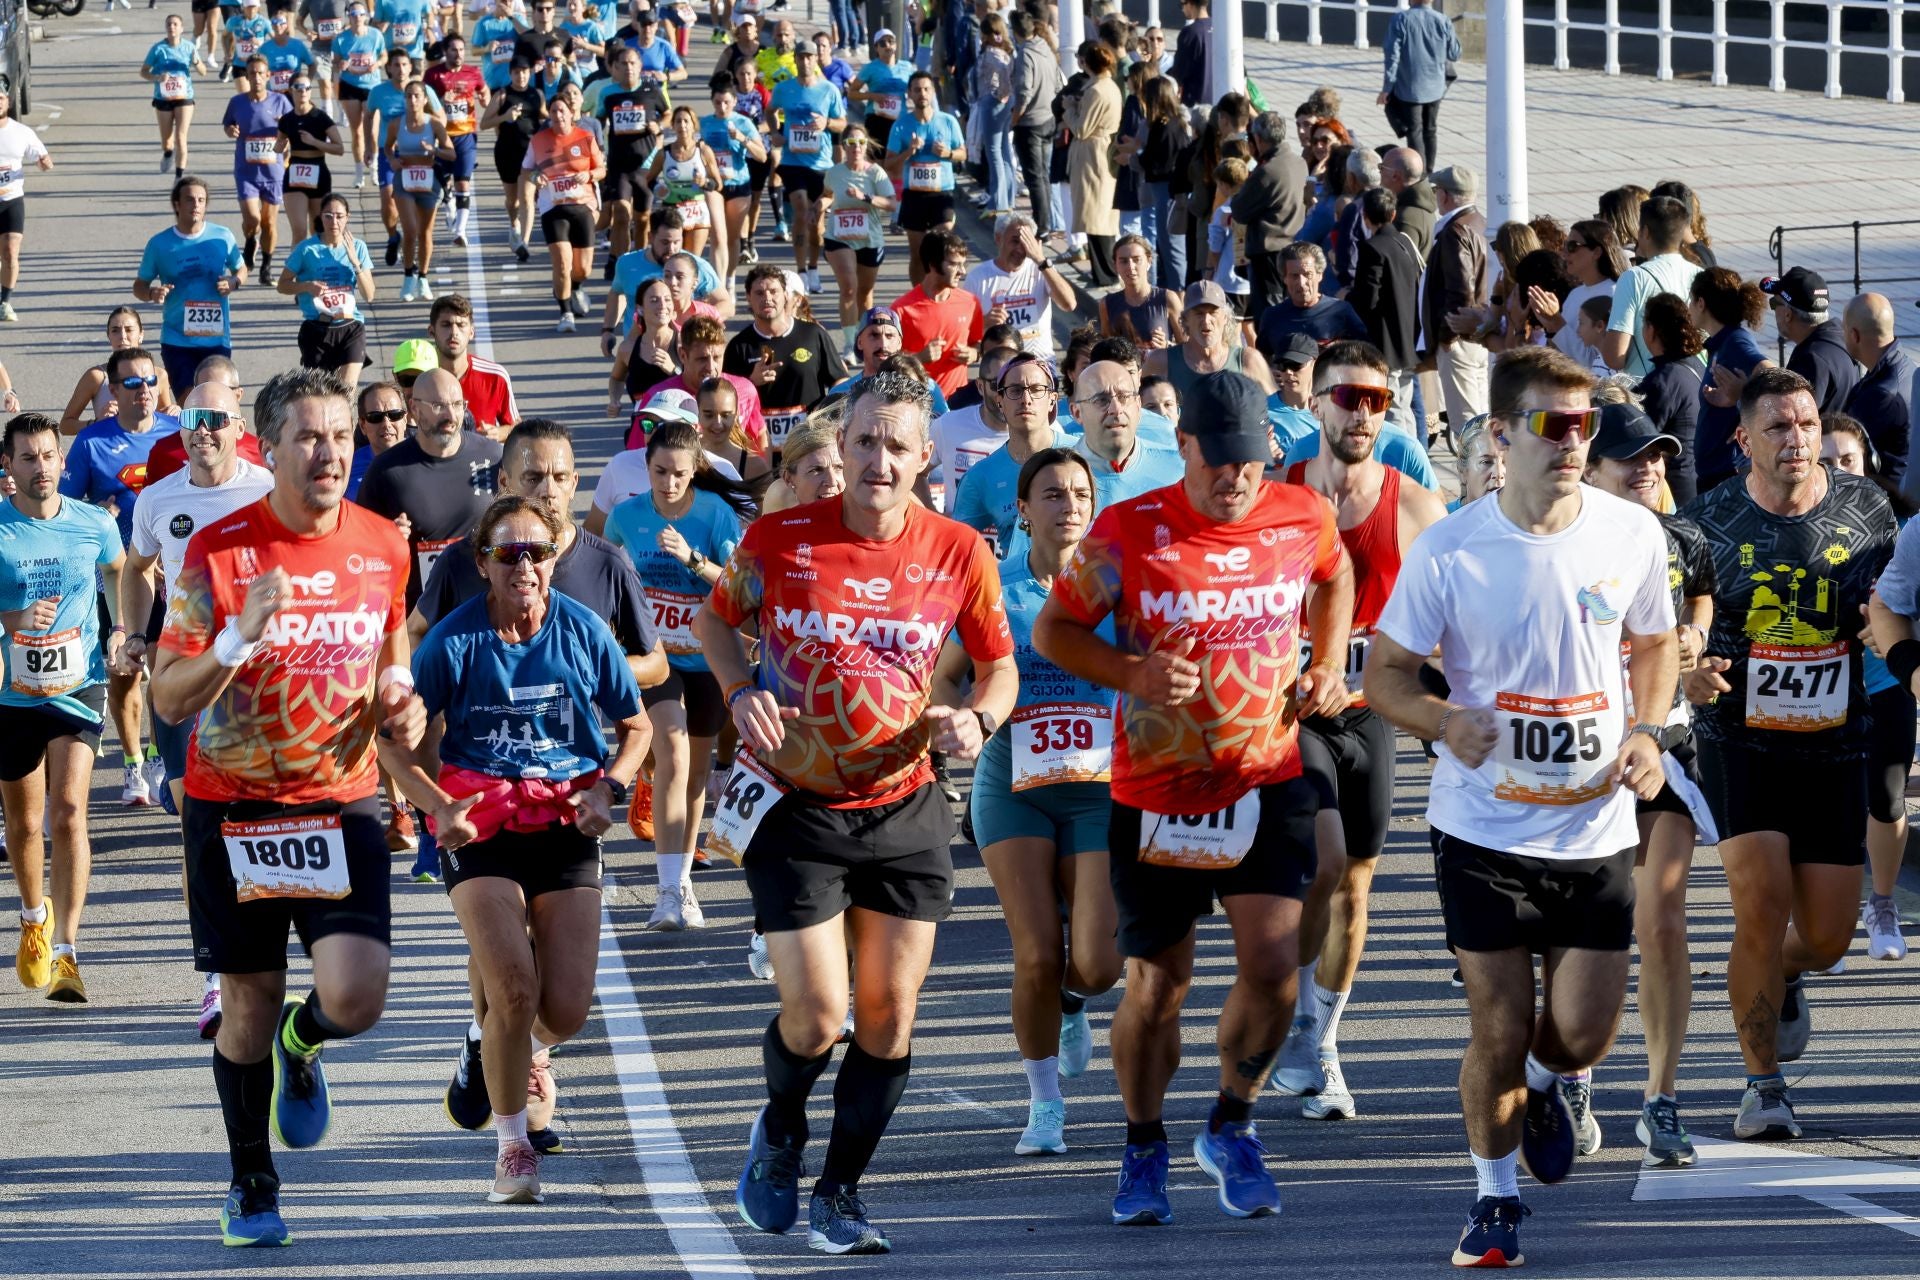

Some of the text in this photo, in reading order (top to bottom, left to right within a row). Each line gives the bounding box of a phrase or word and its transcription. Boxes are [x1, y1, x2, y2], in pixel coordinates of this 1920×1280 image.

[615, 112, 643, 123] 2422
[792, 130, 818, 143] 1784
[249, 142, 273, 153] 1372
[295, 166, 312, 177] 172
[409, 170, 427, 181] 170
[912, 168, 937, 180] 1088
[837, 214, 865, 228] 1578
[322, 292, 347, 309] 687
[187, 308, 222, 323] 2332
[33, 557, 60, 567] MBA
[28, 569, 61, 580] media
[1140, 572, 1306, 623] MARATÓN
[841, 600, 891, 613] TotalEnergies
[652, 602, 694, 631] 764
[228, 602, 388, 647] ARATÓN
[775, 606, 947, 651] MARATÓN
[26, 646, 67, 673] 921
[795, 638, 927, 671] murcia
[836, 669, 889, 678] COSTA CÁLIDA
[1757, 660, 1842, 698] 2477
[1030, 682, 1075, 696] GIJÓN
[1040, 705, 1059, 714] MBA
[1030, 719, 1093, 754] 339
[1510, 718, 1601, 763] 1025
[723, 771, 766, 820] 48
[257, 823, 280, 833] MBA
[239, 835, 331, 871] 1809
